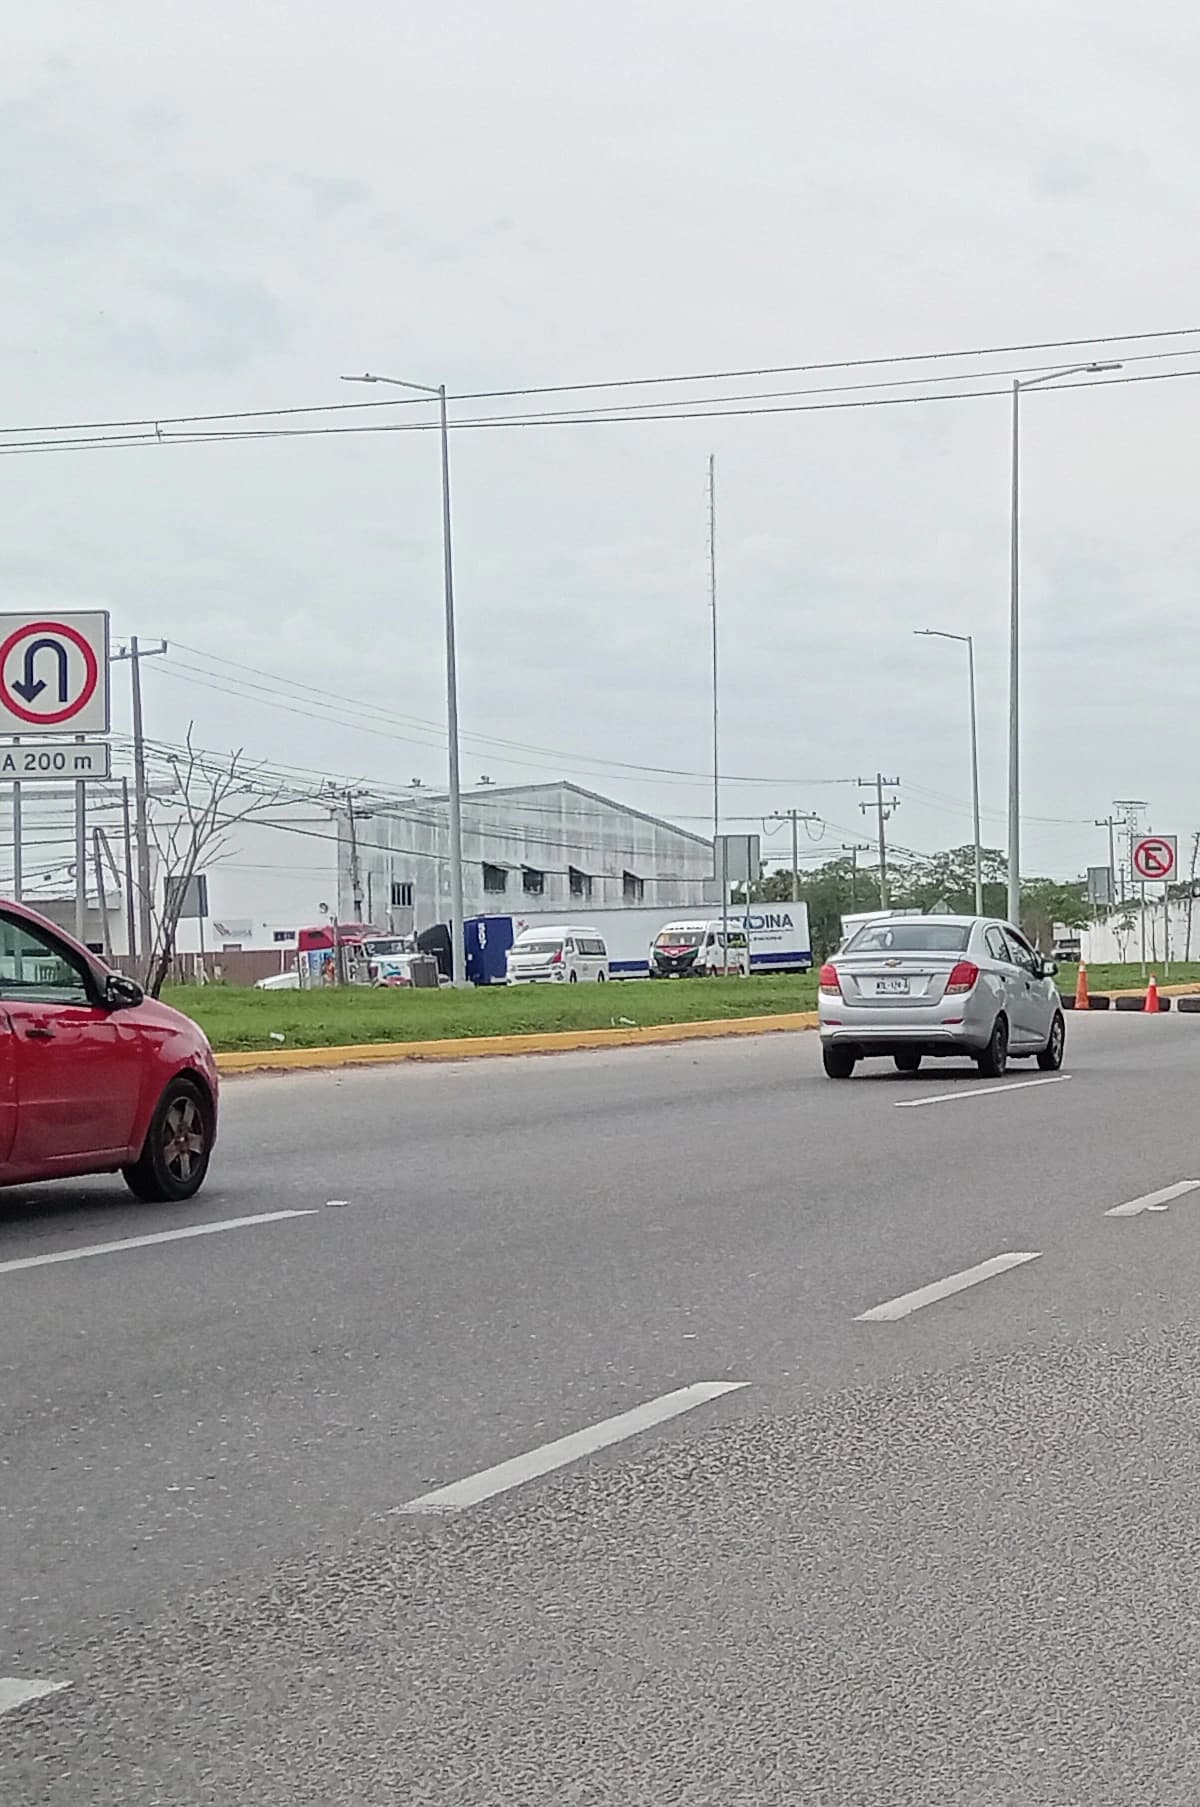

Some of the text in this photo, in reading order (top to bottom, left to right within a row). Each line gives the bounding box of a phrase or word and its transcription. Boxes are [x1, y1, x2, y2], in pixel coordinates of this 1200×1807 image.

[2, 752, 92, 771] A 200 m
